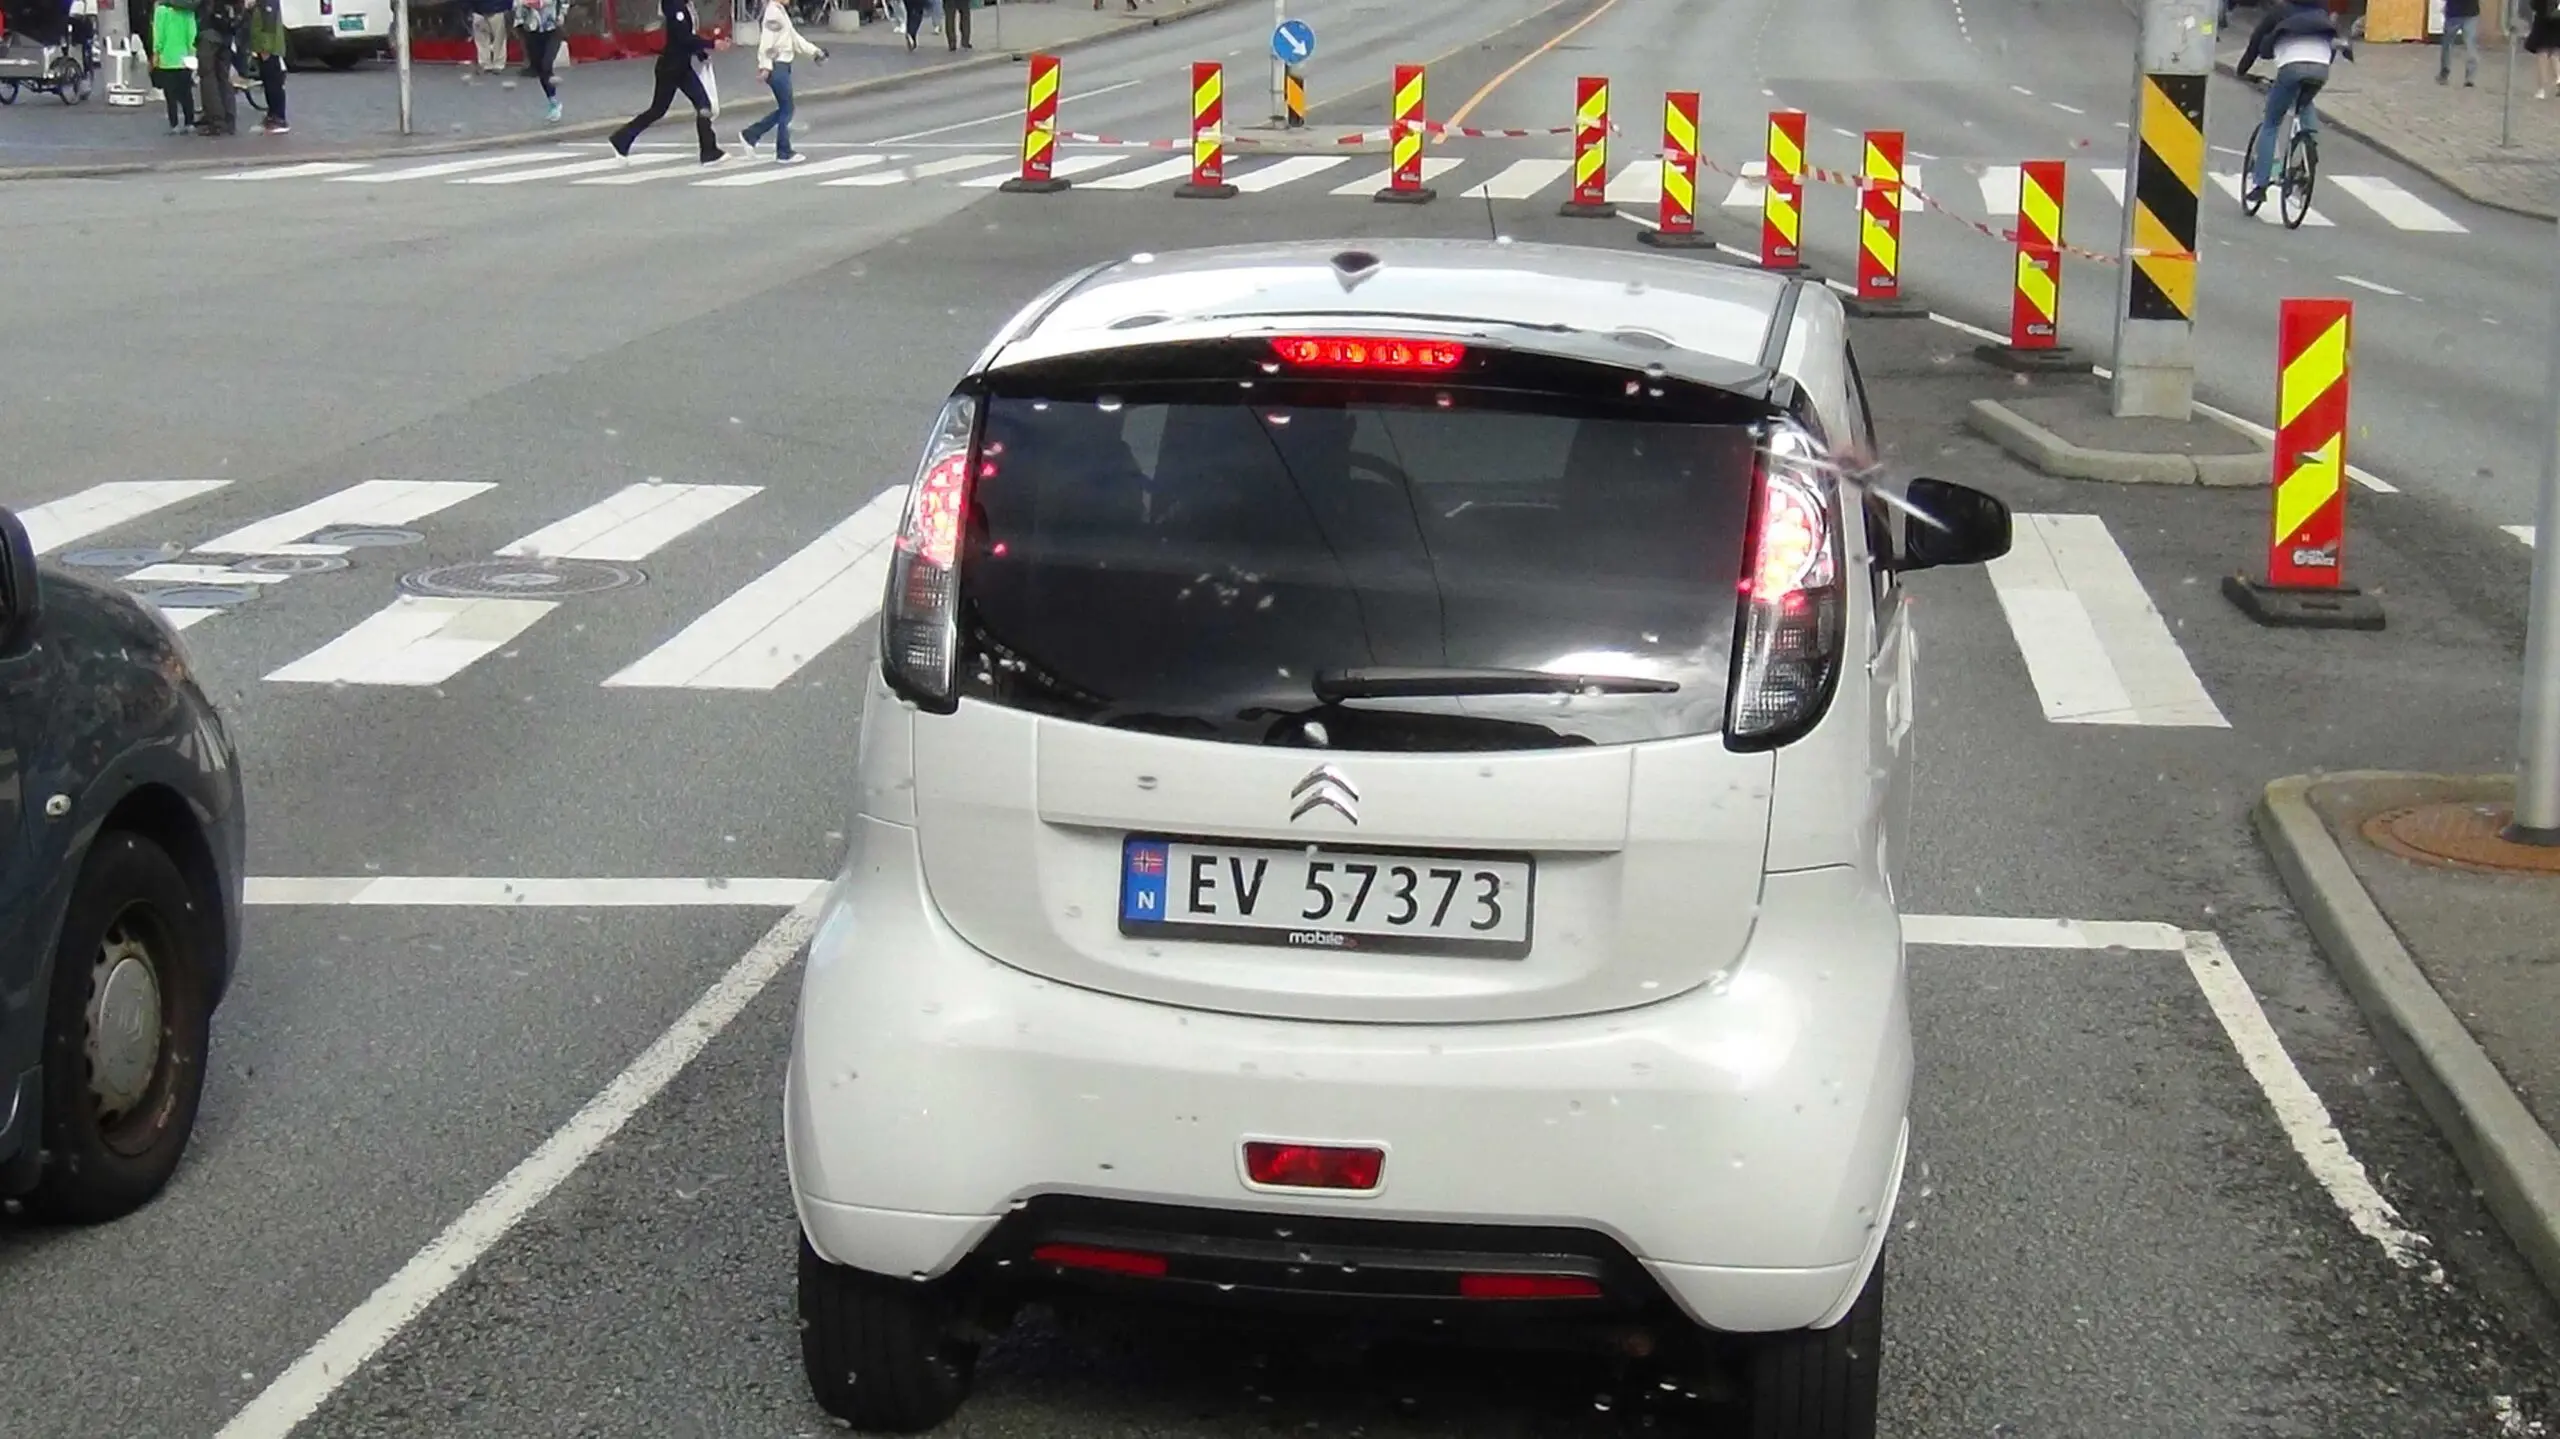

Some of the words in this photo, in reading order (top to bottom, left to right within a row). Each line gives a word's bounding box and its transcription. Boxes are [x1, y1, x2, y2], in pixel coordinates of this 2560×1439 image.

[1137, 890, 1155, 910] N
[1189, 854, 1269, 916] EV
[1302, 861, 1502, 931] 57373
